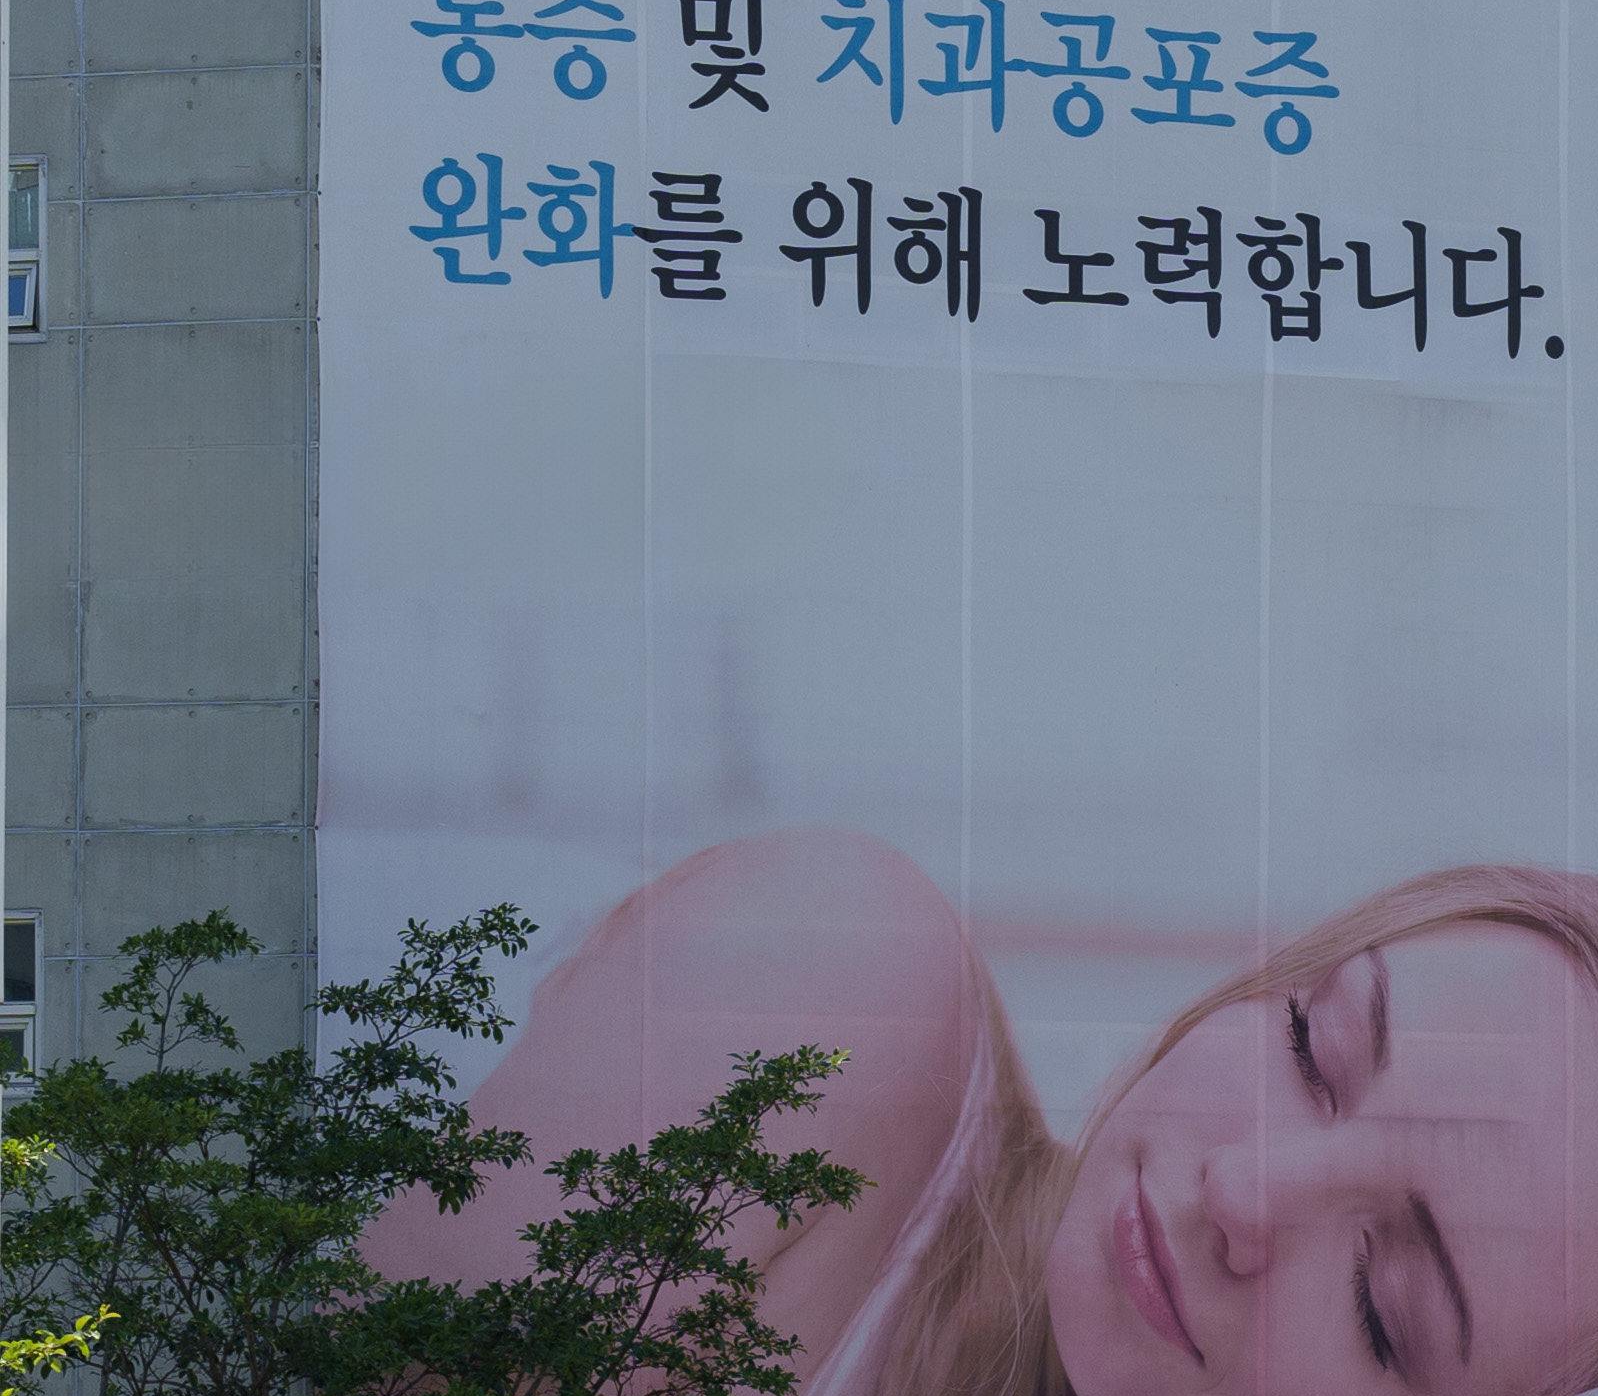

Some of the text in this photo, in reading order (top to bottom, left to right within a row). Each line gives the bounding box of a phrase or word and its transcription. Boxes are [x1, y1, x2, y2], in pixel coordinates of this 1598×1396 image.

[409, 152, 1565, 360] 완화를 위해 노력합니다.
